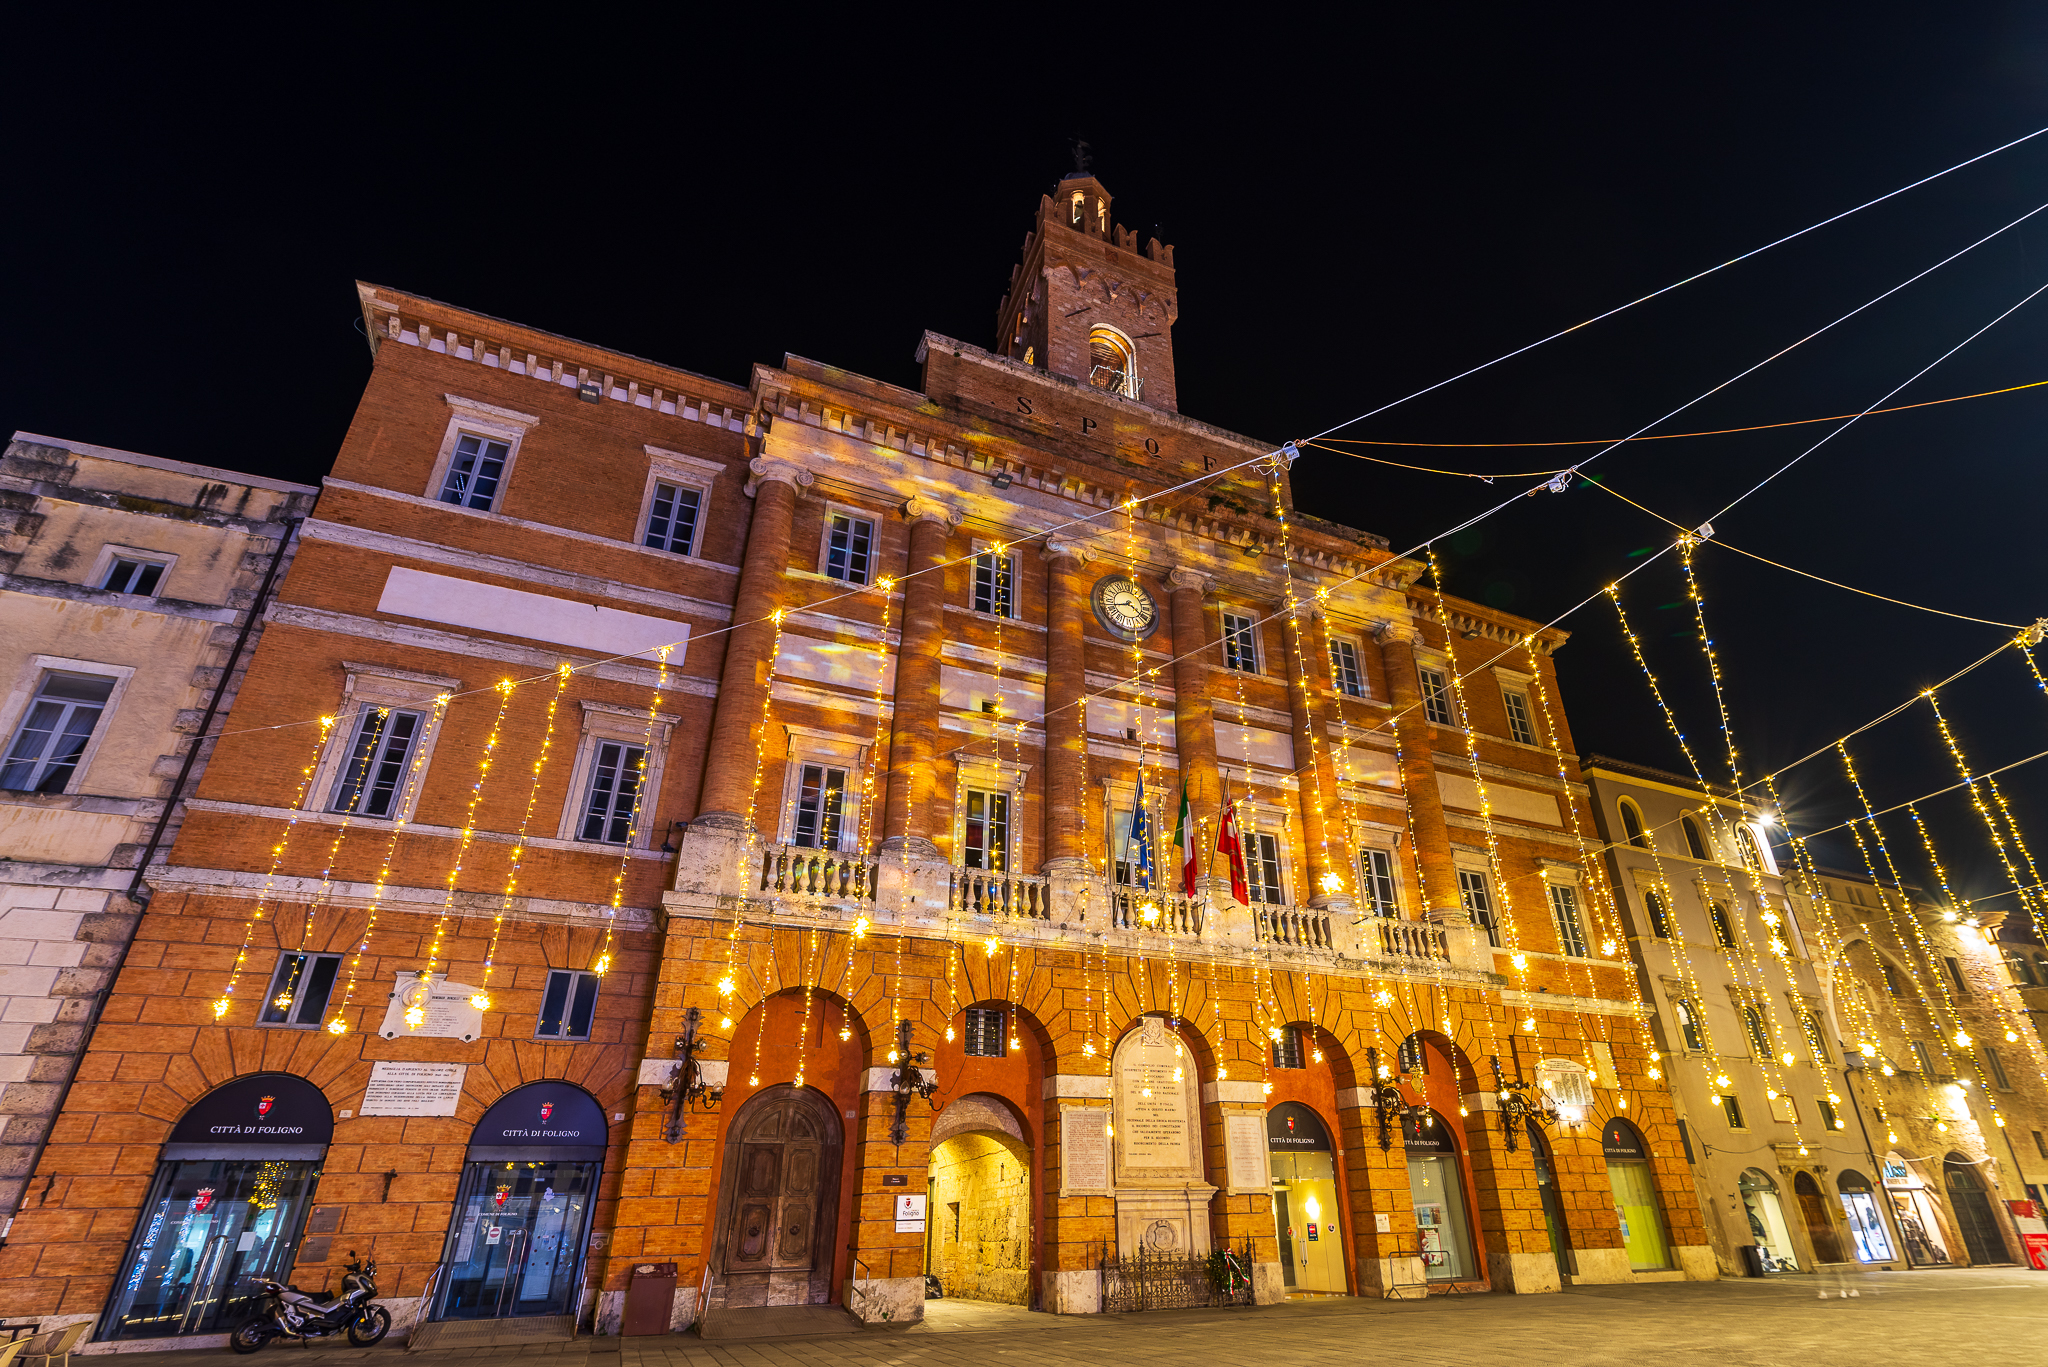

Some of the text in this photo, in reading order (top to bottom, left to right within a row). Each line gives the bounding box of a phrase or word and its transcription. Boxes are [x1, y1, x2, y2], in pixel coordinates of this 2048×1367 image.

[1017, 396, 1217, 472] S P Q F
[210, 1124, 303, 1134] CITTÀ DI FOLIGNO
[502, 1128, 529, 1137] CITTÀ
[542, 1130, 580, 1138] FOLIGNO
